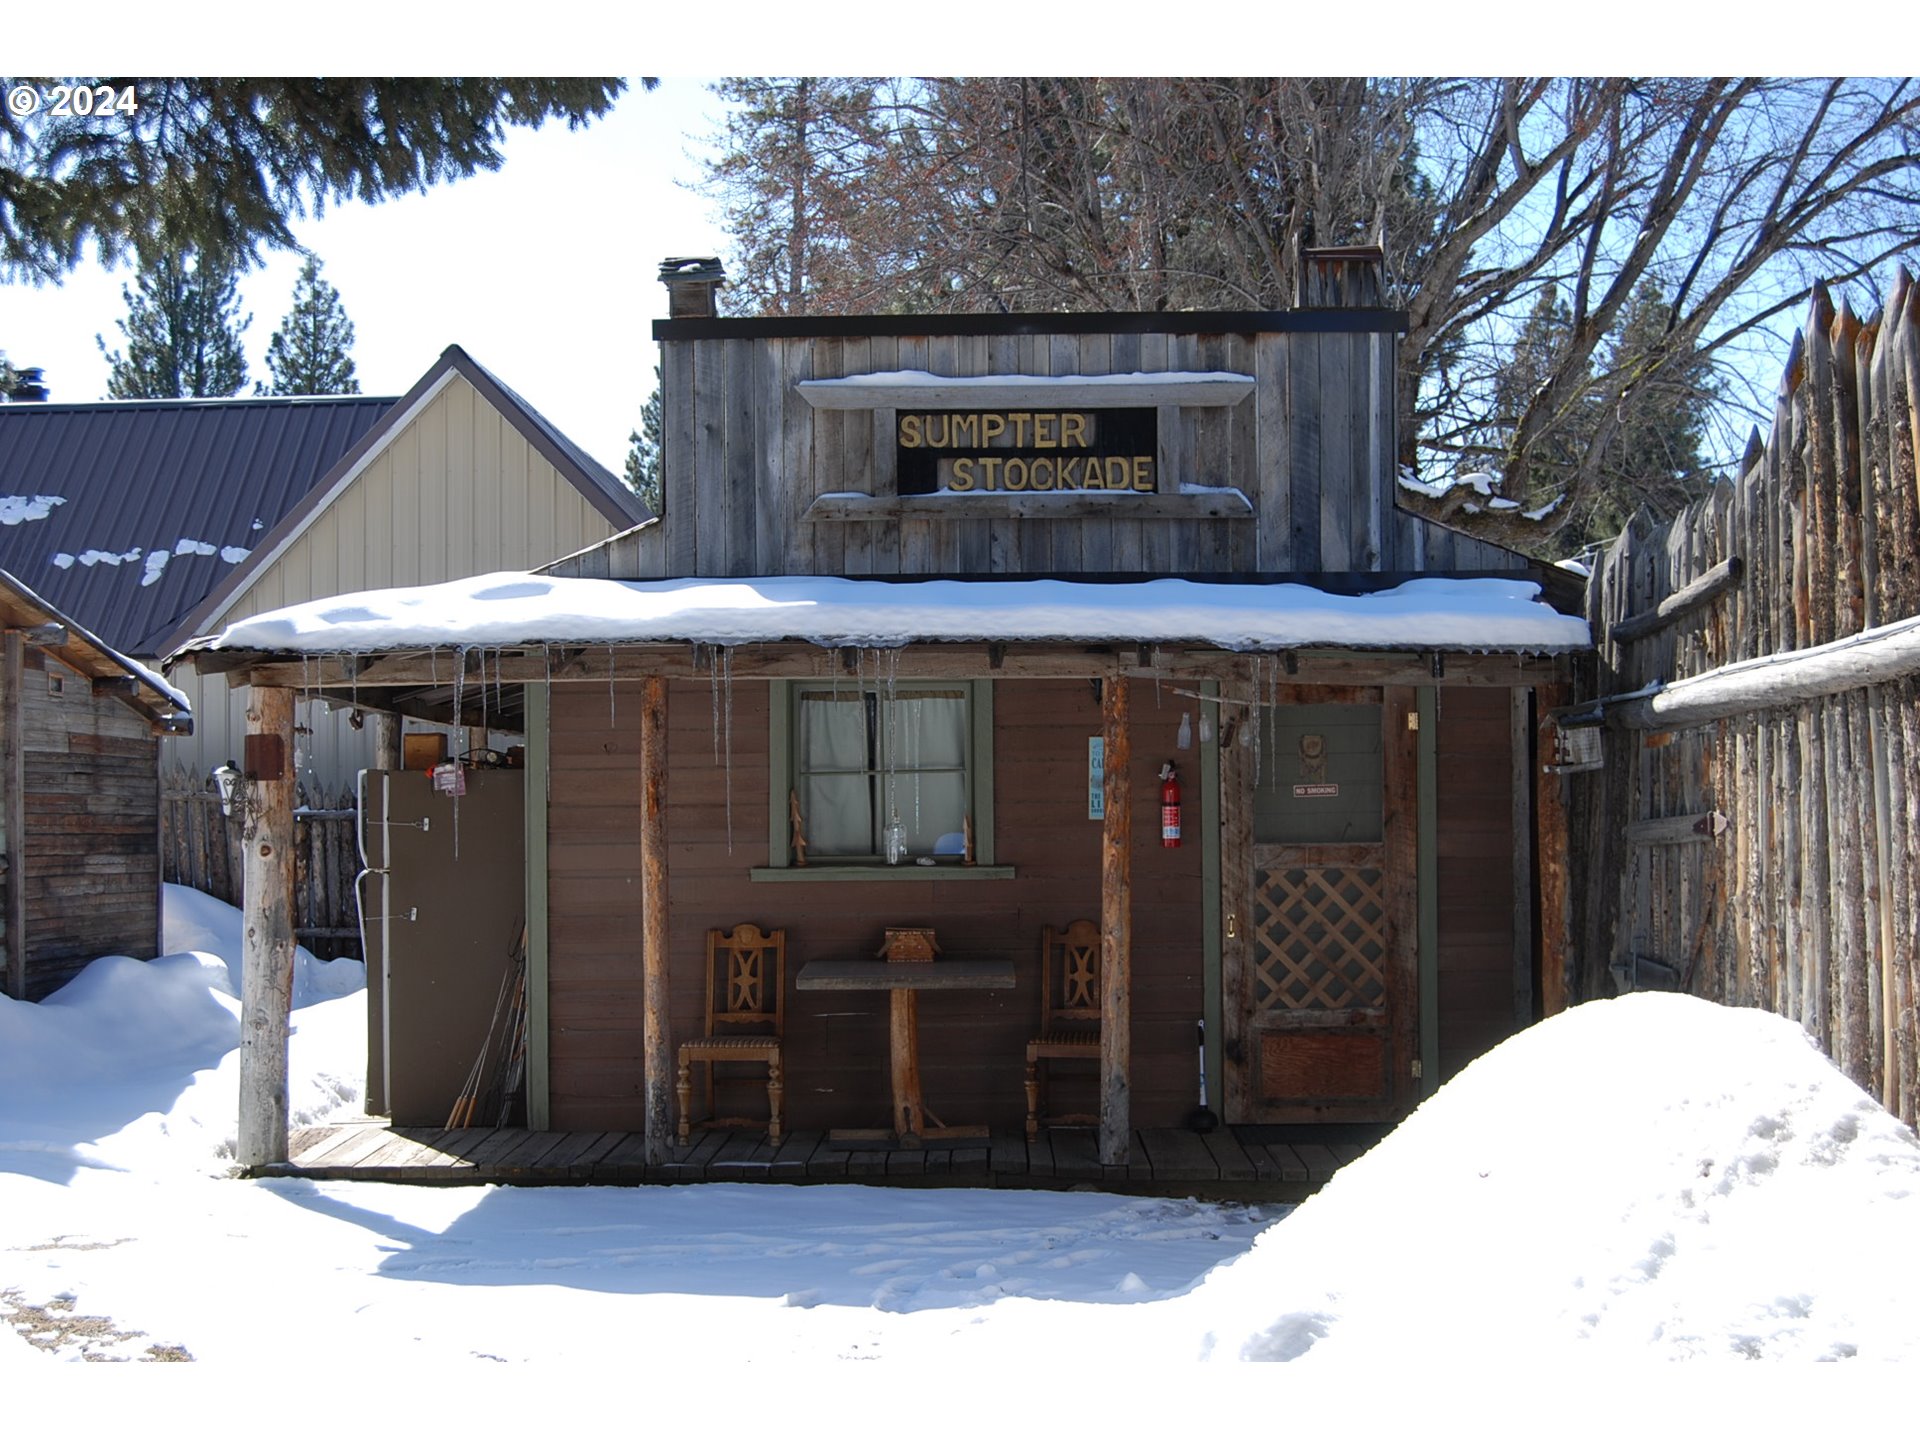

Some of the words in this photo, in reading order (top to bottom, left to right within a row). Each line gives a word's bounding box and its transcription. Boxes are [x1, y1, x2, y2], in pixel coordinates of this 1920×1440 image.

[899, 413, 1088, 448] SUMPTER
[949, 456, 1153, 491] STOCKADE
[1306, 787, 1336, 795] SMOKING
